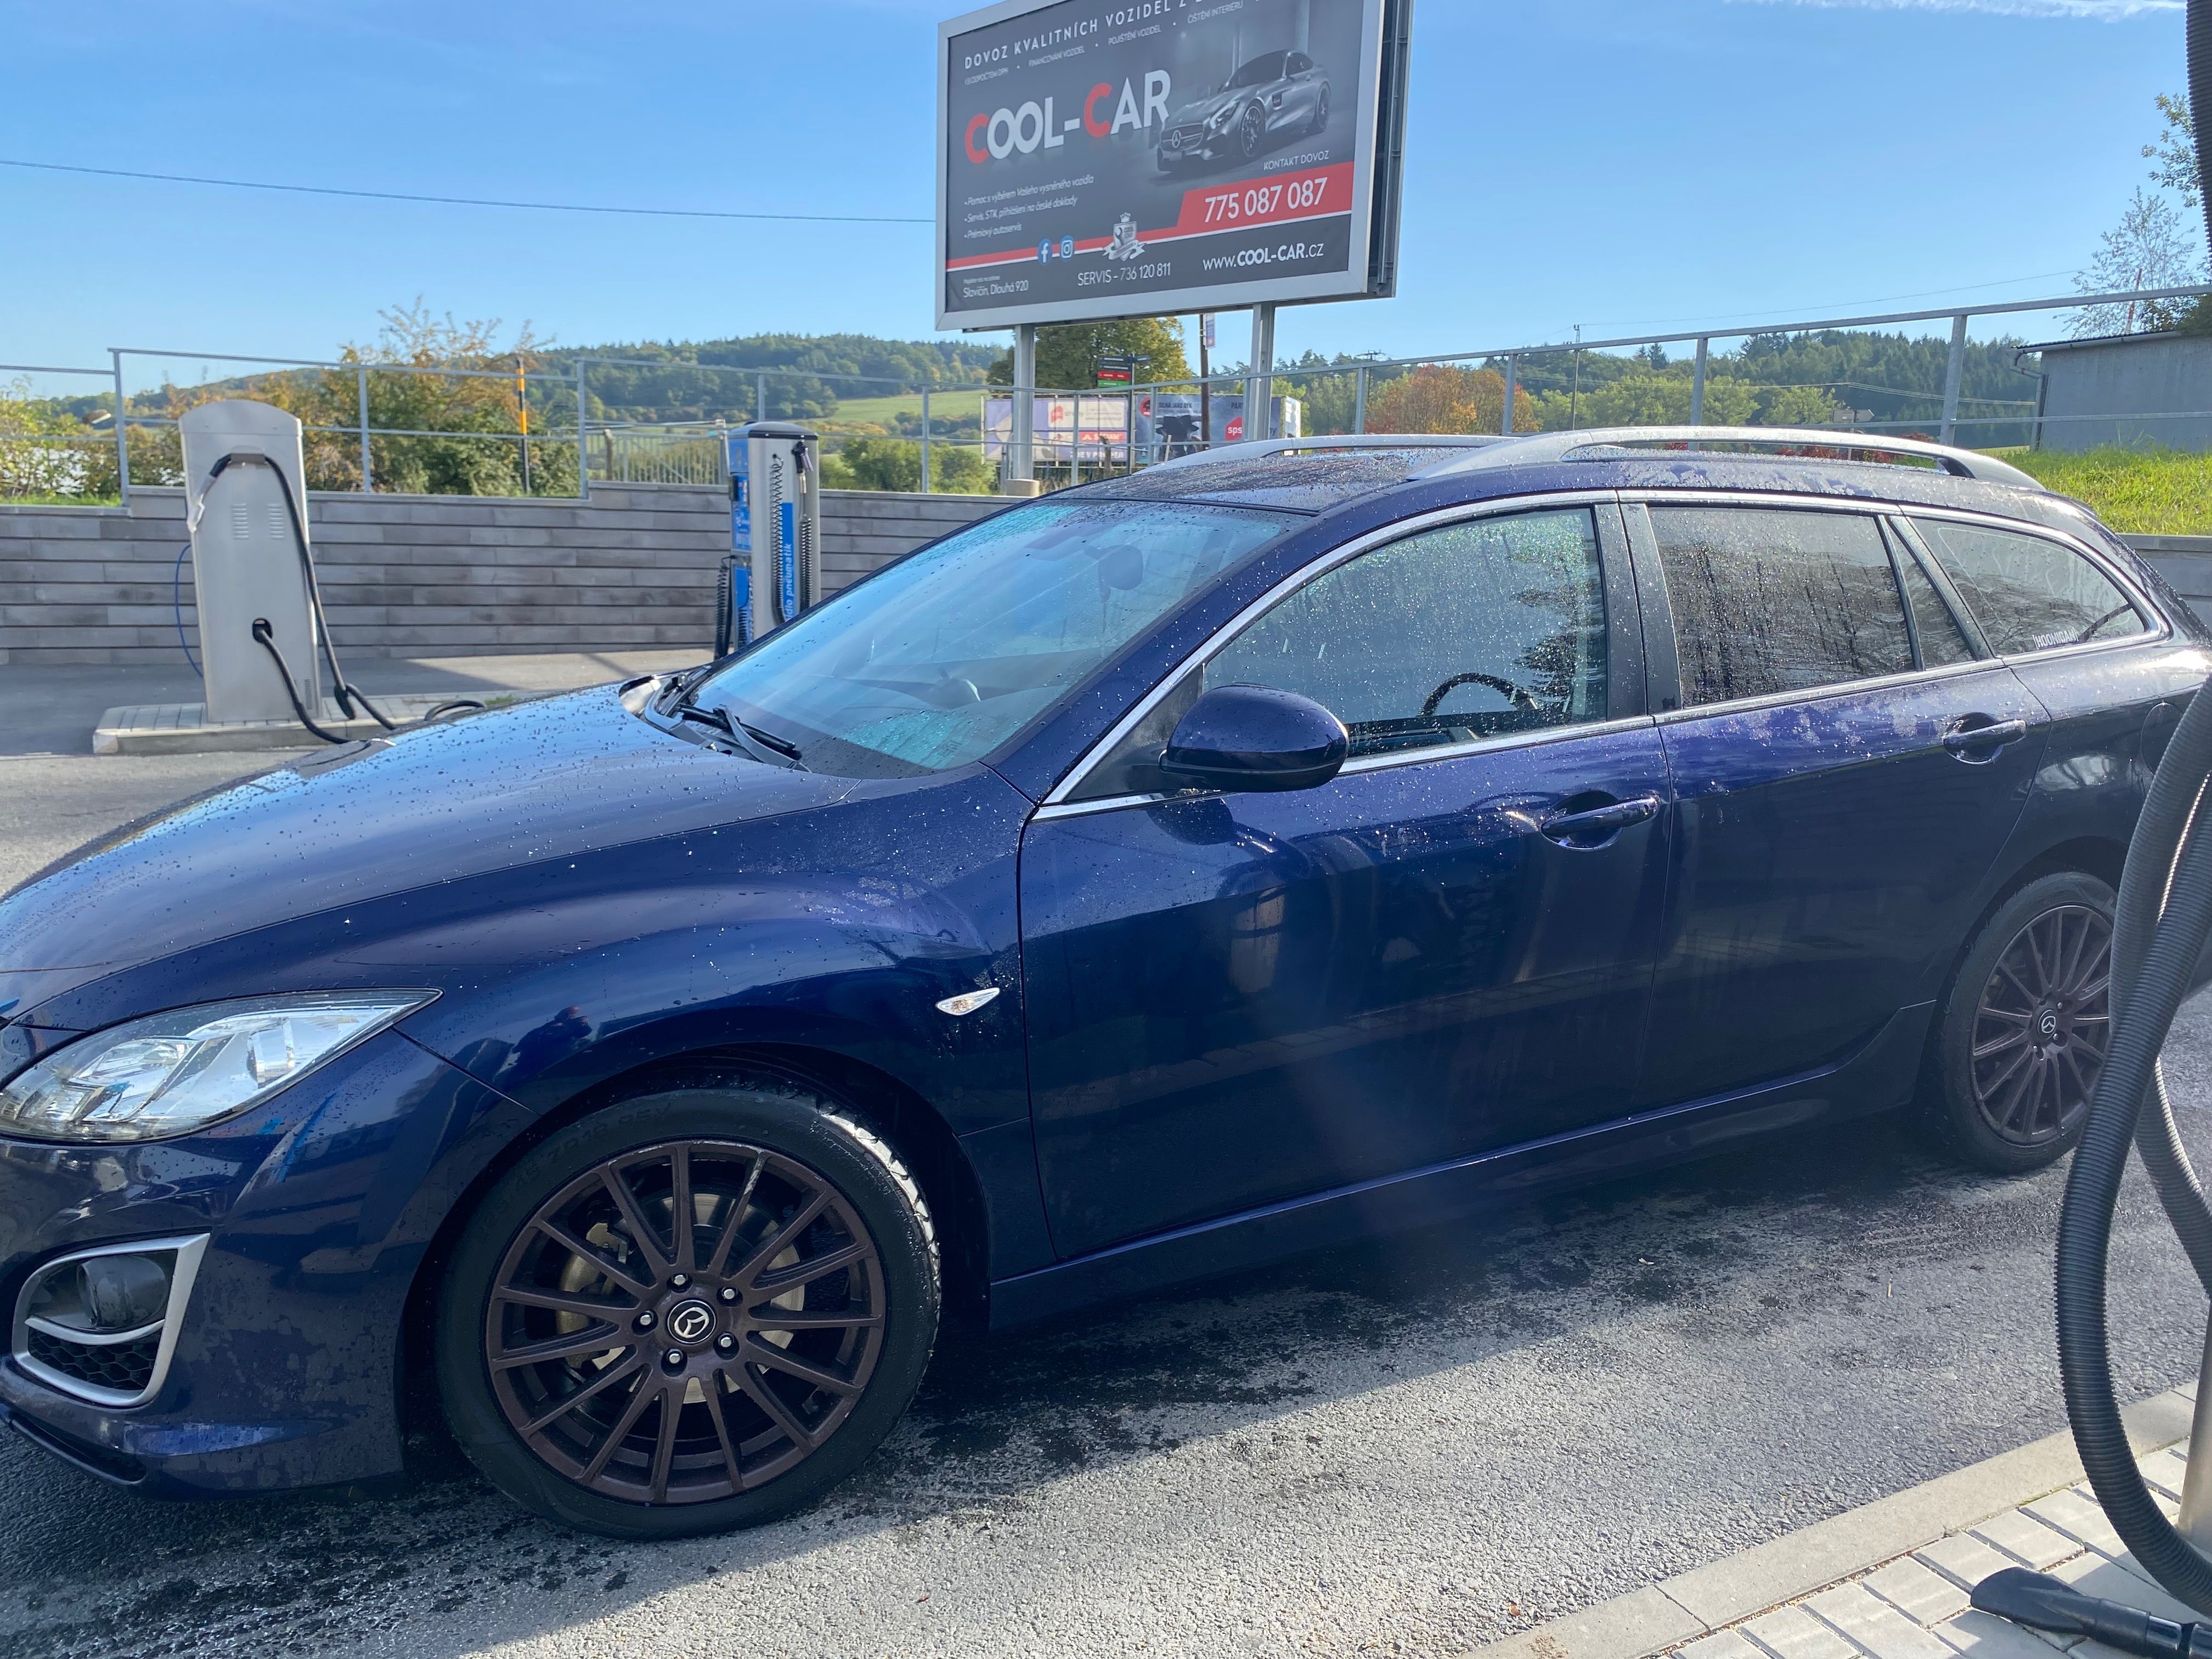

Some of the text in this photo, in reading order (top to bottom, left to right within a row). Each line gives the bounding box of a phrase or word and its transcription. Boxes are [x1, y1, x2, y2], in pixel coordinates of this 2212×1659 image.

[964, 46, 1008, 70] DOVOZ
[1014, 18, 1098, 55] KVALITNÍCH
[1105, 0, 1171, 27] VOZIDEL
[965, 70, 1171, 163] COOL-CAR
[1263, 150, 1329, 171] KONTAKT DOVOZ
[1204, 177, 1328, 223] 775 087 087
[990, 282, 1015, 295] Dlouhá
[1015, 280, 1029, 292] 920
[1077, 269, 1112, 286] SERVIS
[1119, 267, 1137, 281] 736
[1138, 264, 1155, 279] 120
[1156, 262, 1171, 277] 811
[1227, 427, 1243, 436] sps
[783, 543, 794, 596] pneumatik
